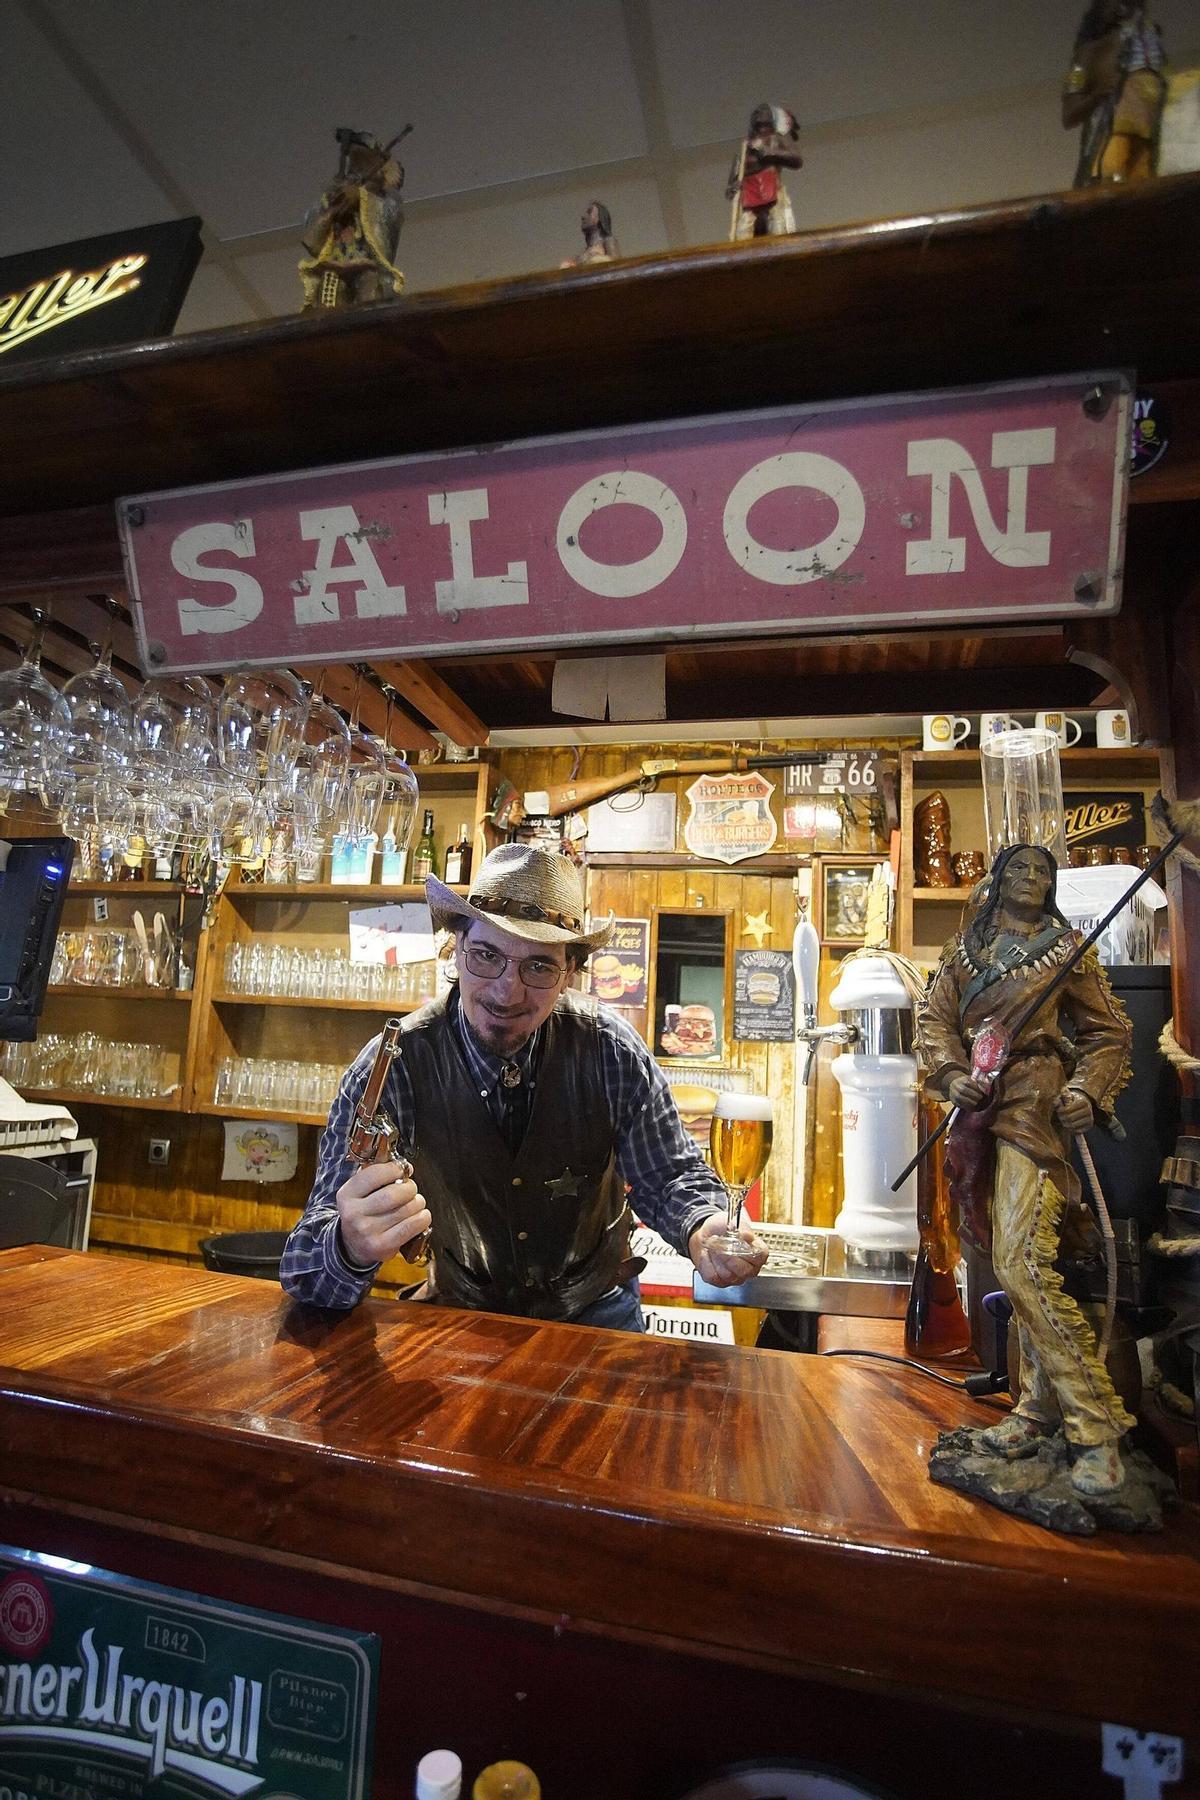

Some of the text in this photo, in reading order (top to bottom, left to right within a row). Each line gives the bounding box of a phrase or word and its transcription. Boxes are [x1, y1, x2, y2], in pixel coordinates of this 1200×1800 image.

[0, 255, 147, 346] iller
[168, 426, 1057, 637] SALOON
[848, 760, 876, 786] 66
[699, 783, 745, 796] ROUTE
[642, 1311, 719, 1338] Corona
[153, 1625, 190, 1652] 1842
[0, 1627, 263, 1778] ner Urquell
[280, 1677, 337, 1701] Pilsner
